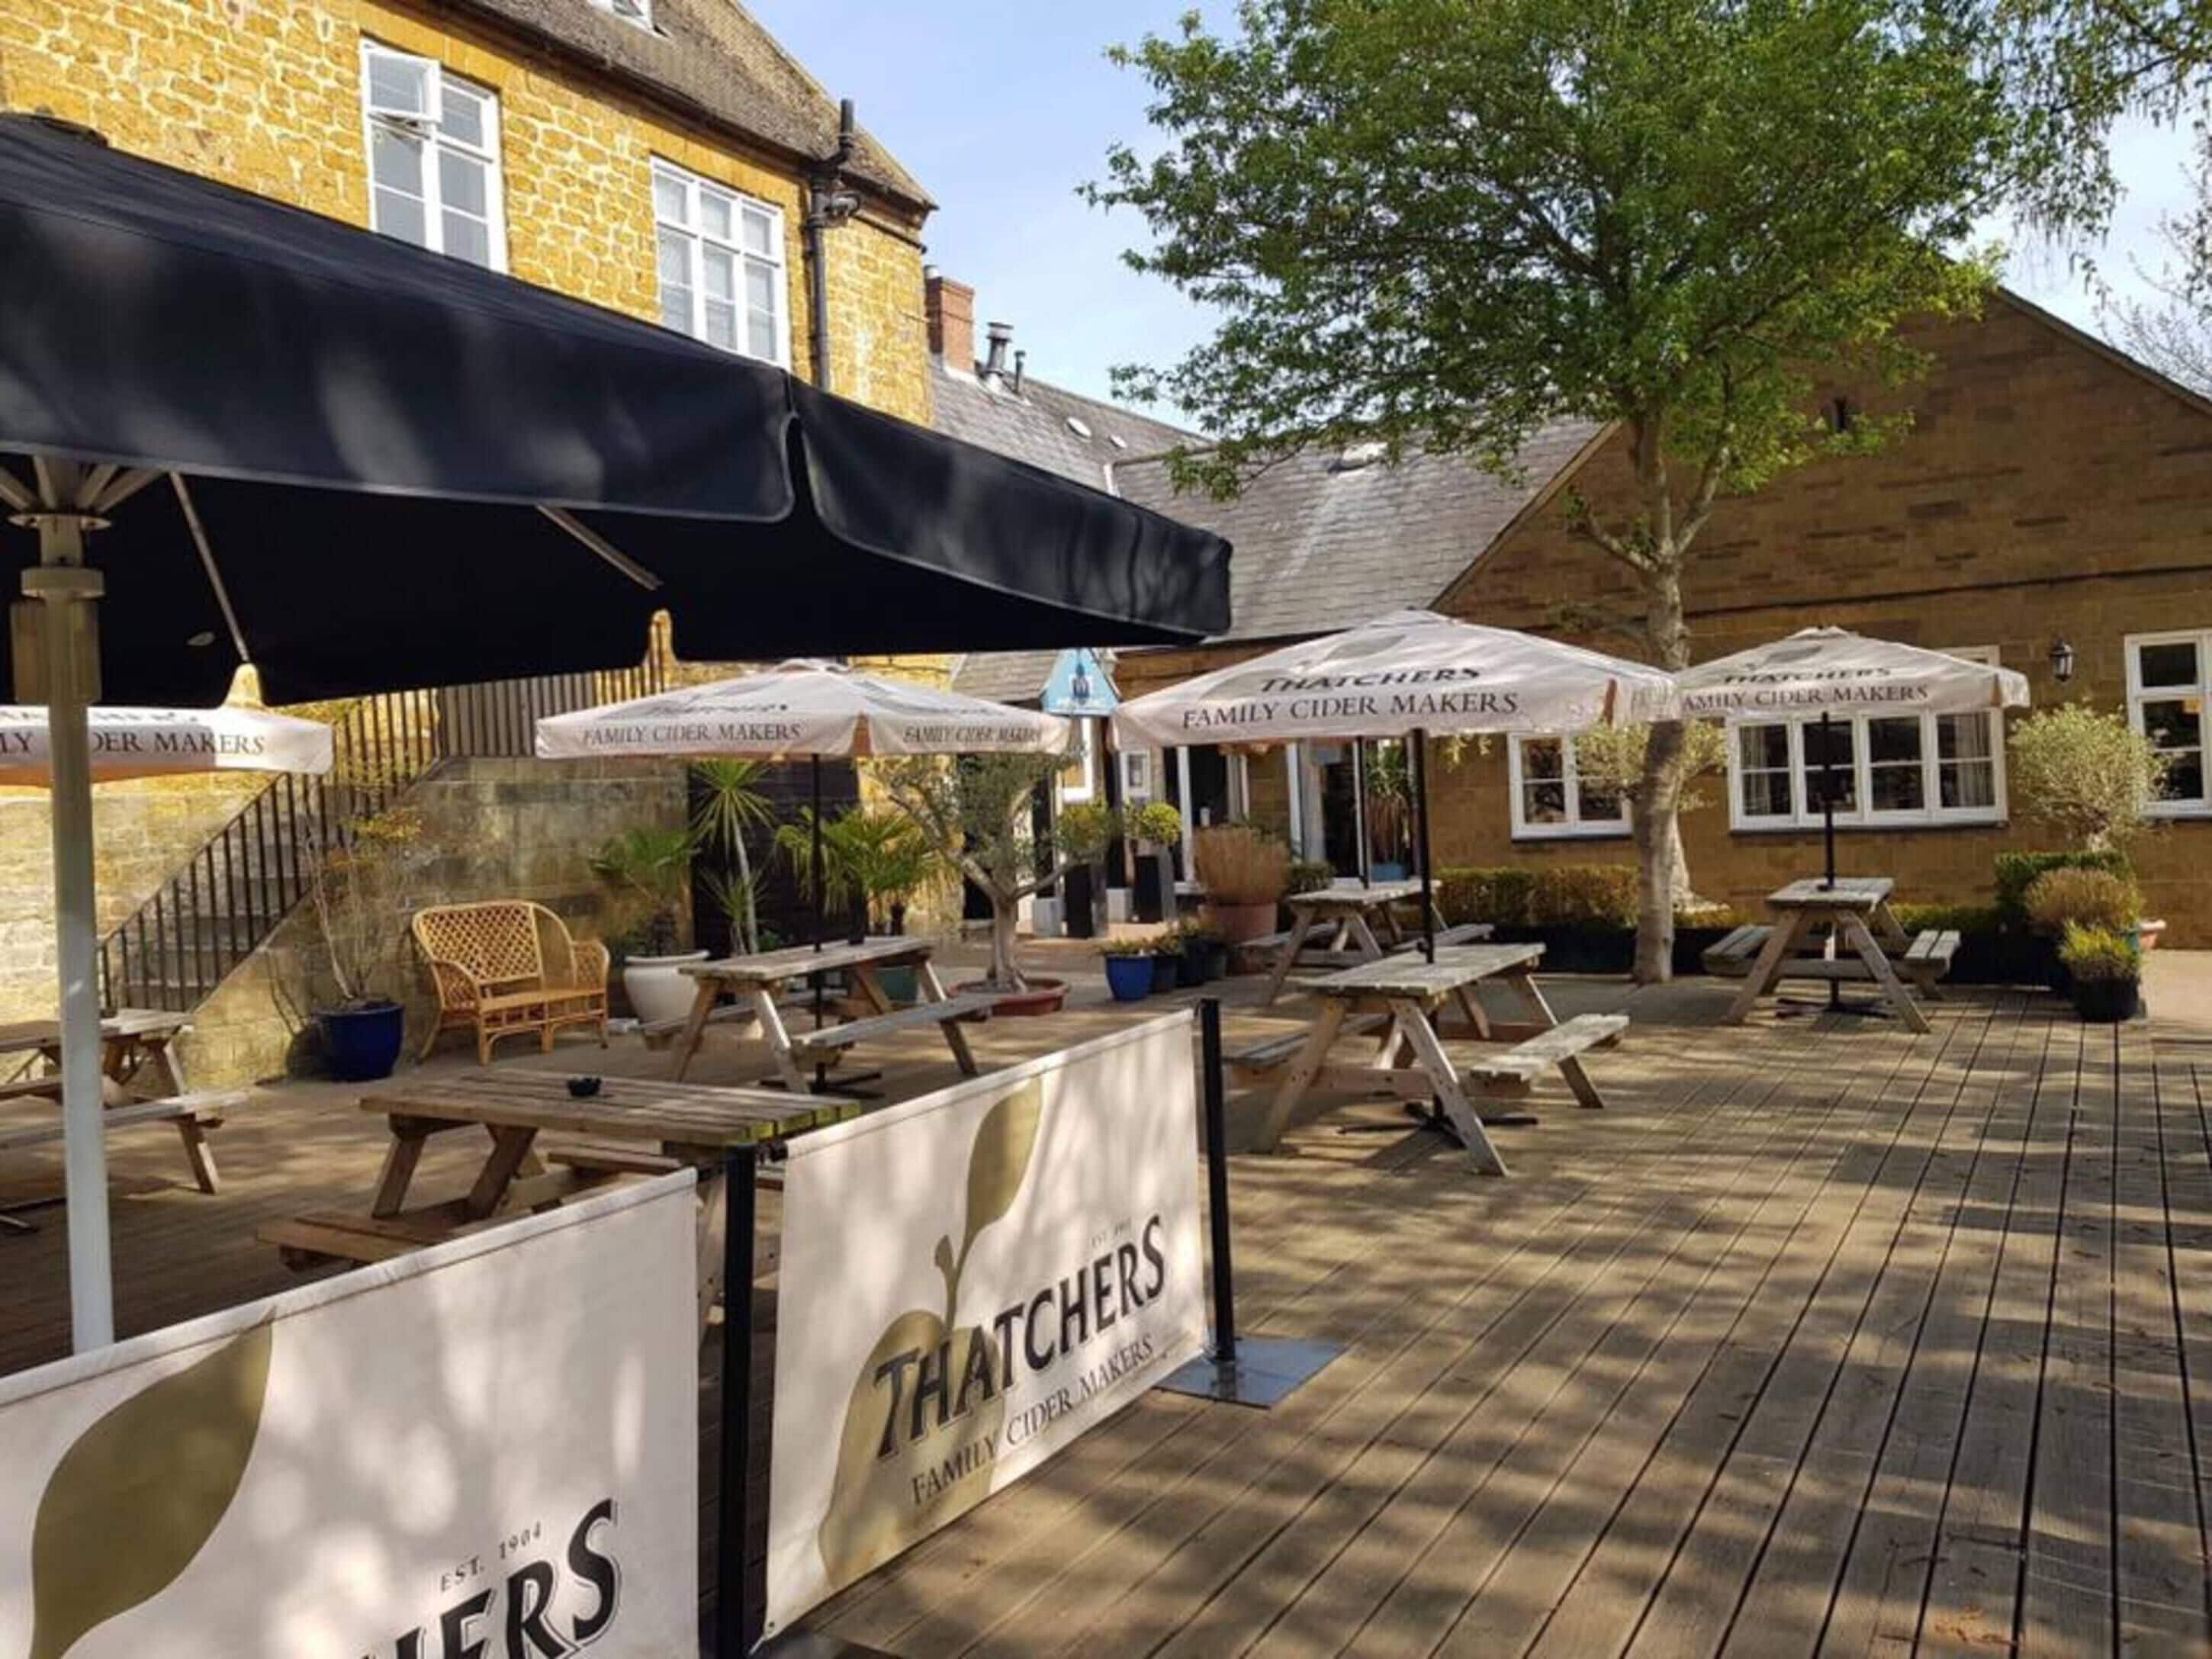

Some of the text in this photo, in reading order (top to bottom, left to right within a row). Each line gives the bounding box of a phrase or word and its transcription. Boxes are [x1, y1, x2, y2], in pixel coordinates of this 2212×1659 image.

[1261, 668, 1480, 692] THATCHERS
[1182, 693, 1518, 728] FAMILY CIDER MAKERS
[1682, 690, 1747, 711] AMILY
[1755, 688, 1825, 706] CIDER
[1832, 684, 1928, 703] MAKERS
[154, 731, 265, 754] MAKERS
[584, 723, 800, 744] FAMILY CIDER MAKERS
[873, 1214, 1165, 1459] THATCHERS
[912, 1333, 1154, 1503] FAMILY CIDER MAKERS
[440, 1522, 541, 1592] EST. 1904
